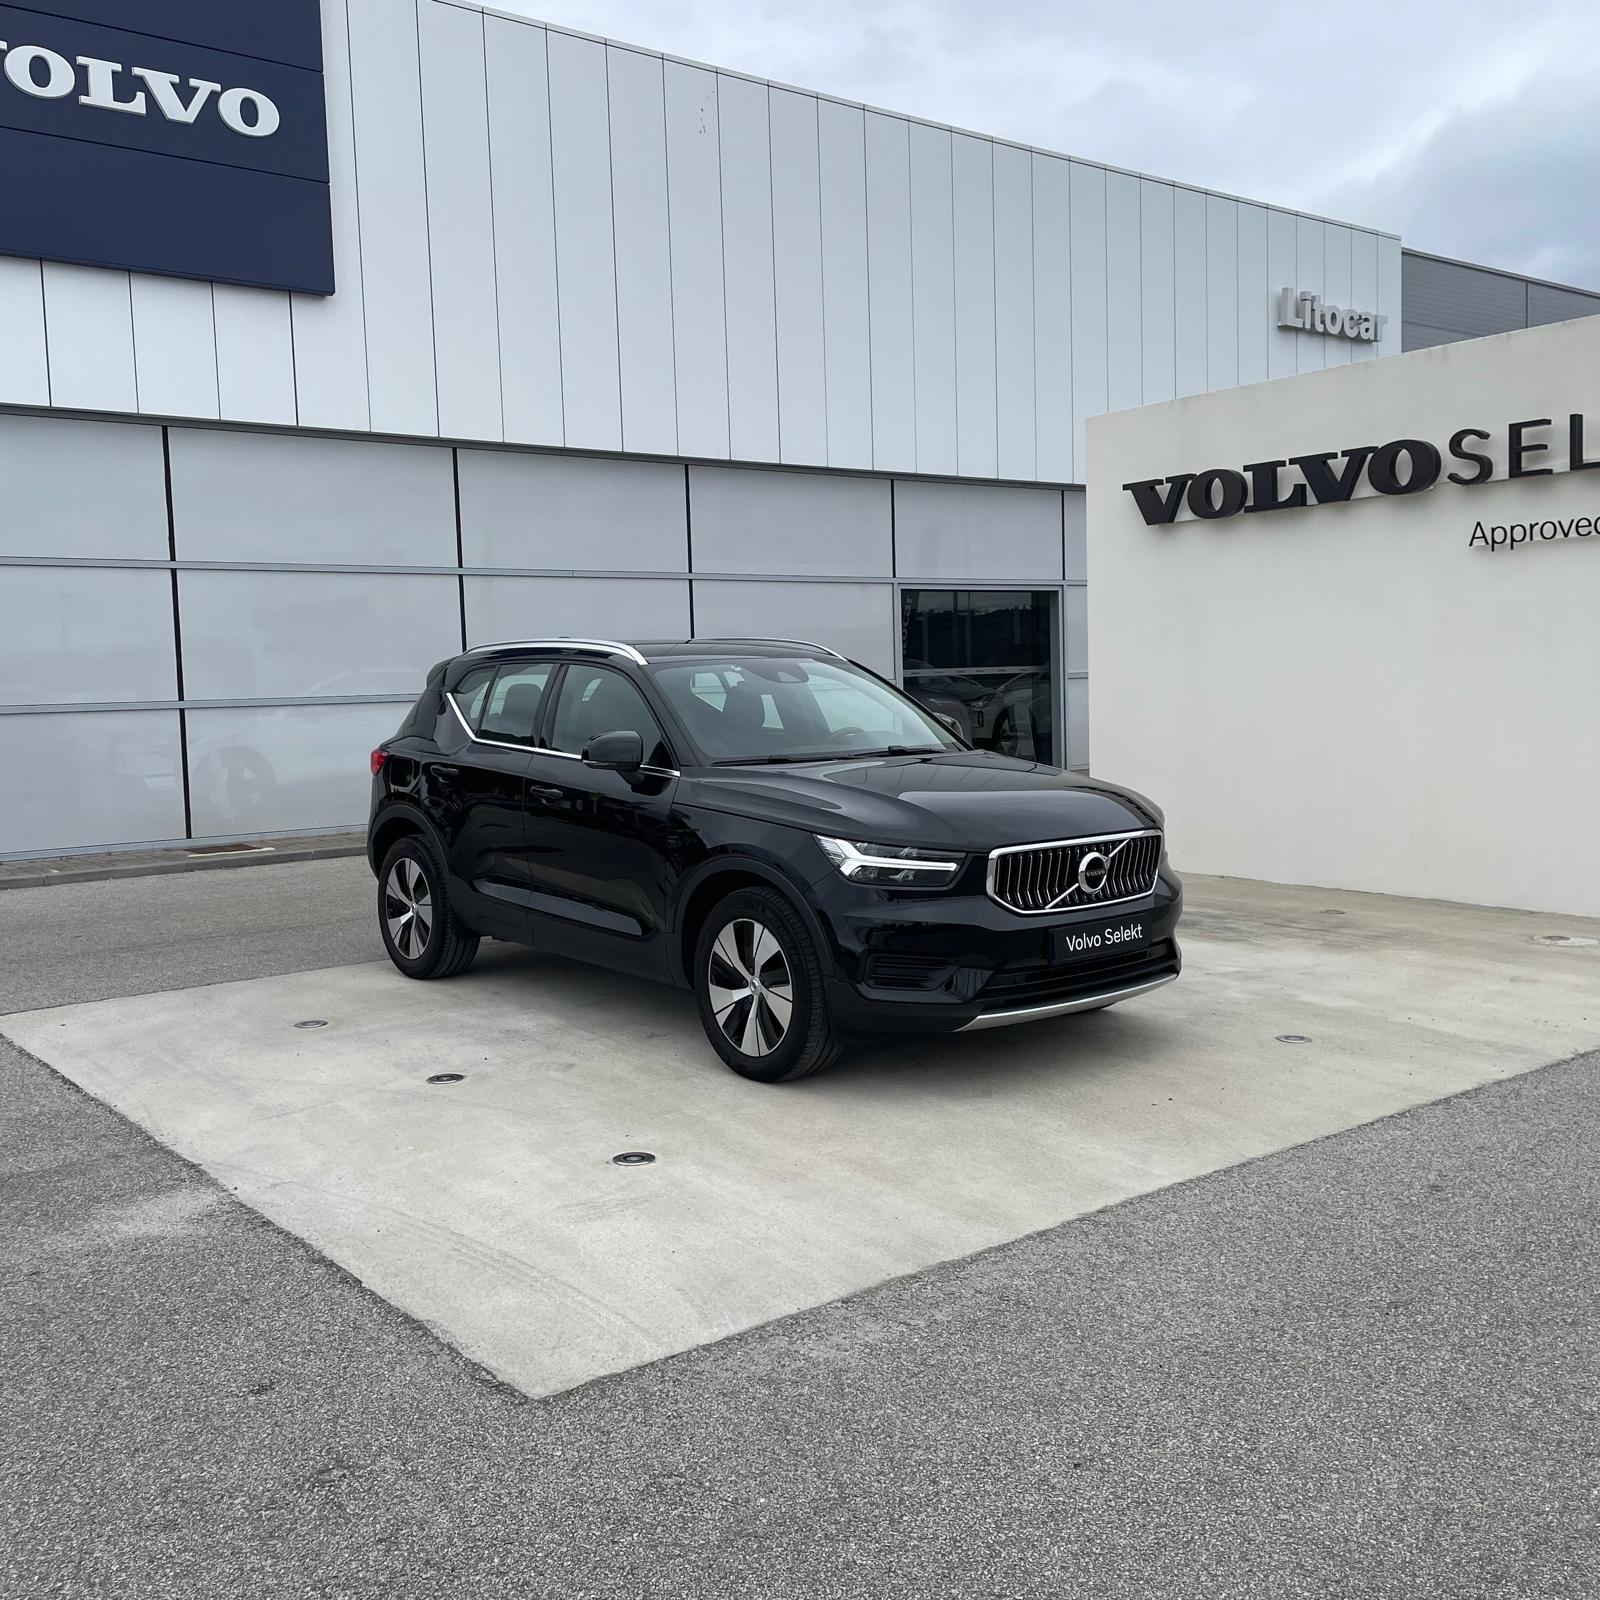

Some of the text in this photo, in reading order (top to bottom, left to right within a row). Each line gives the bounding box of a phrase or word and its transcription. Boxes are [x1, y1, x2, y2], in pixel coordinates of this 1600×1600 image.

[0, 40, 280, 137] OLVO
[1278, 287, 1388, 342] Litocar
[1122, 413, 1600, 526] VOLVO SEL
[1086, 869, 1106, 877] VOLVO
[1066, 923, 1143, 951] Volvo Selekt
